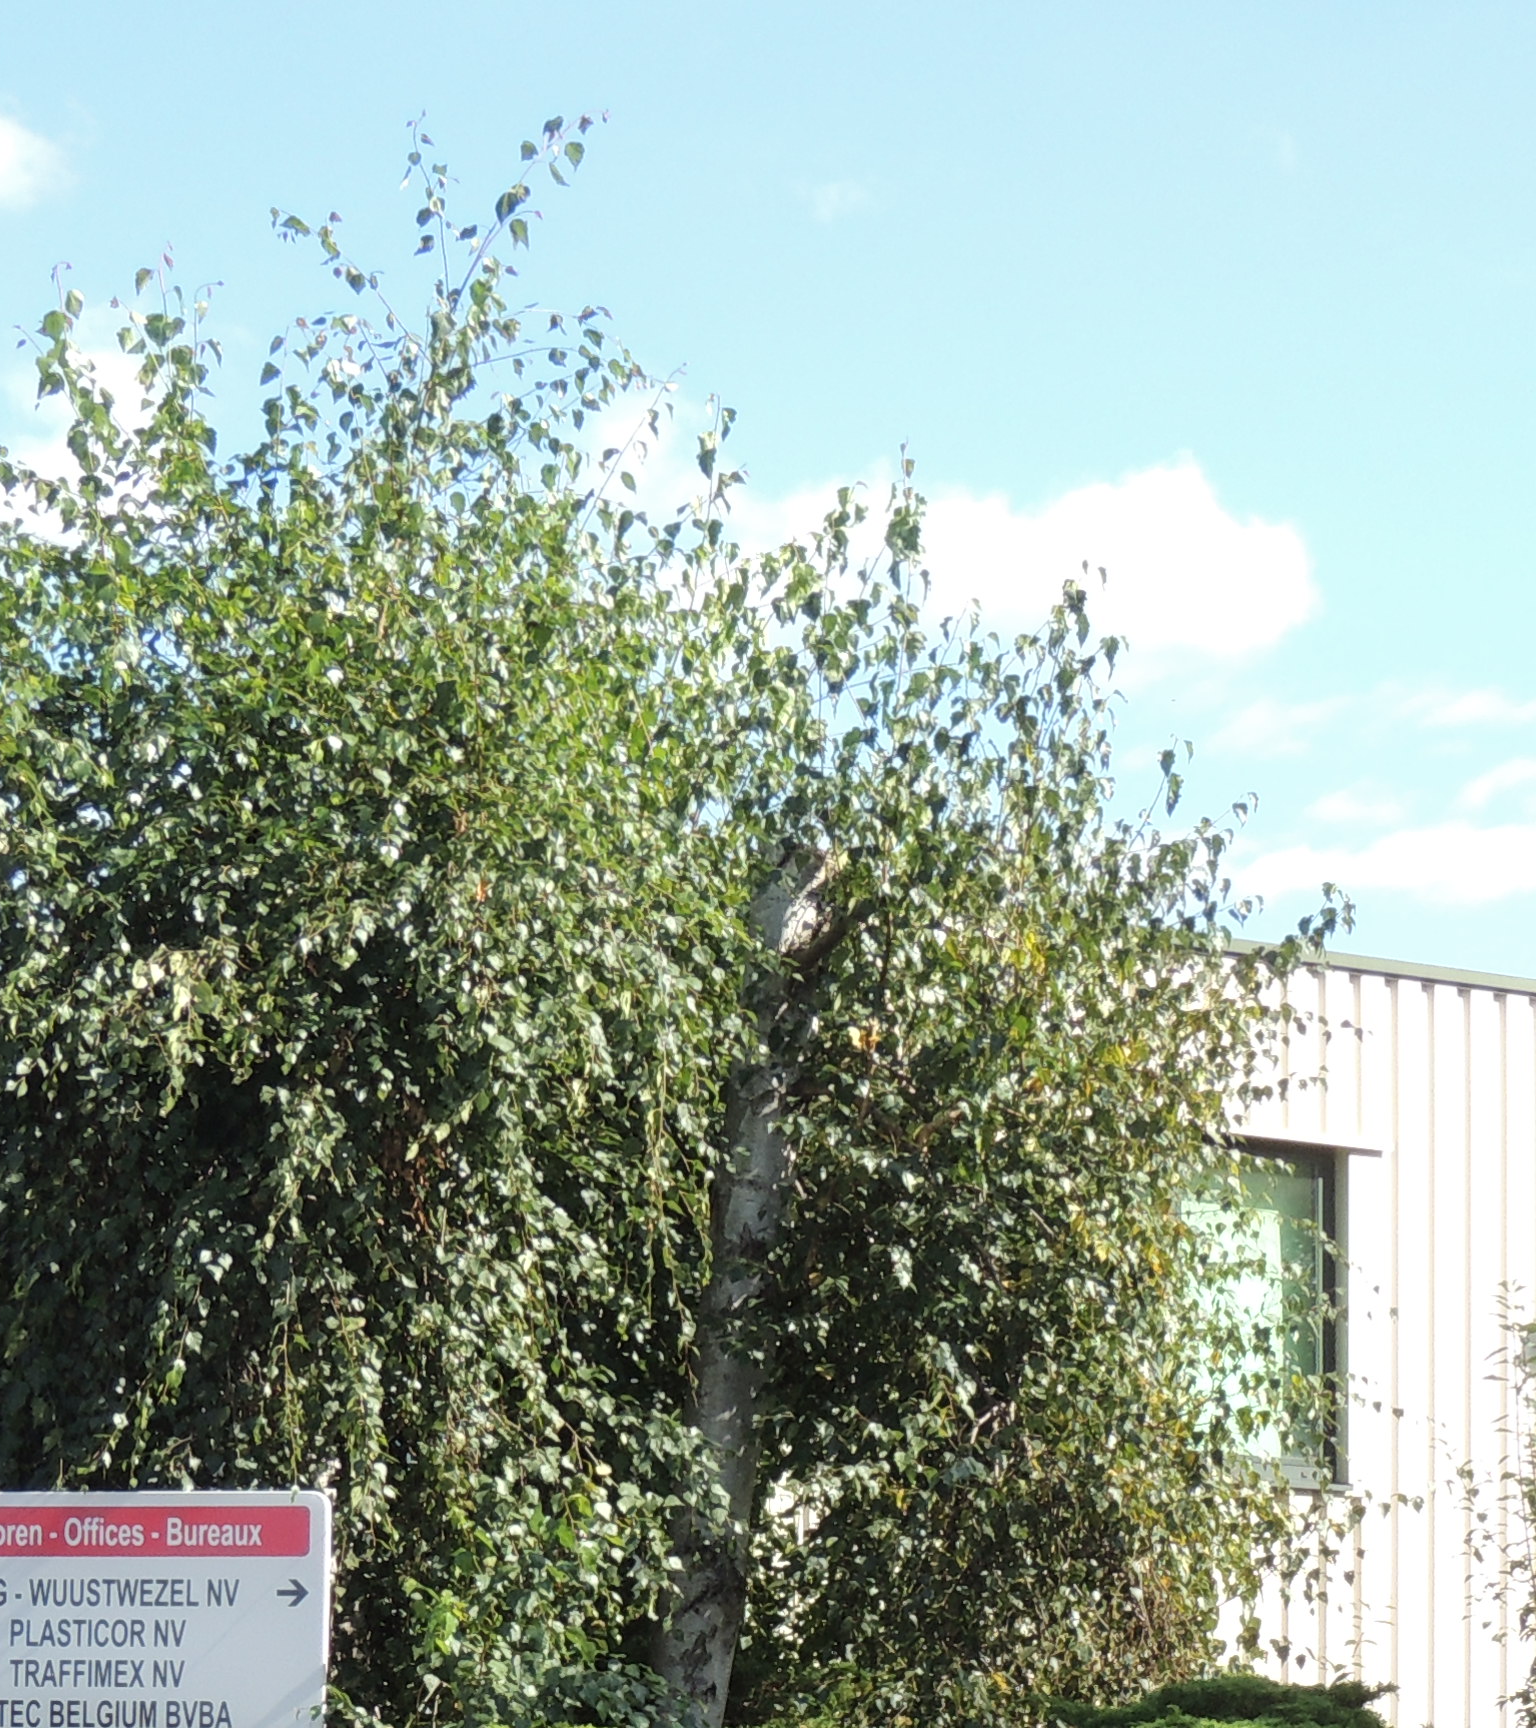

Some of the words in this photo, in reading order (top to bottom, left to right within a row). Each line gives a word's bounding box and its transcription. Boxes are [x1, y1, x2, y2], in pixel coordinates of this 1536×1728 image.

[64, 1516, 145, 1547] Offices
[166, 1517, 262, 1547] Bureaux
[29, 1578, 200, 1607] WUUSTWEZEL
[207, 1578, 240, 1607] NV
[9, 1618, 146, 1648] PLASTICOR
[153, 1619, 187, 1648] NV
[9, 1659, 145, 1688] TRAFFIMEX
[152, 1659, 185, 1688] NV
[49, 1700, 157, 1728] BELGIUM
[165, 1700, 232, 1728] BVBA
